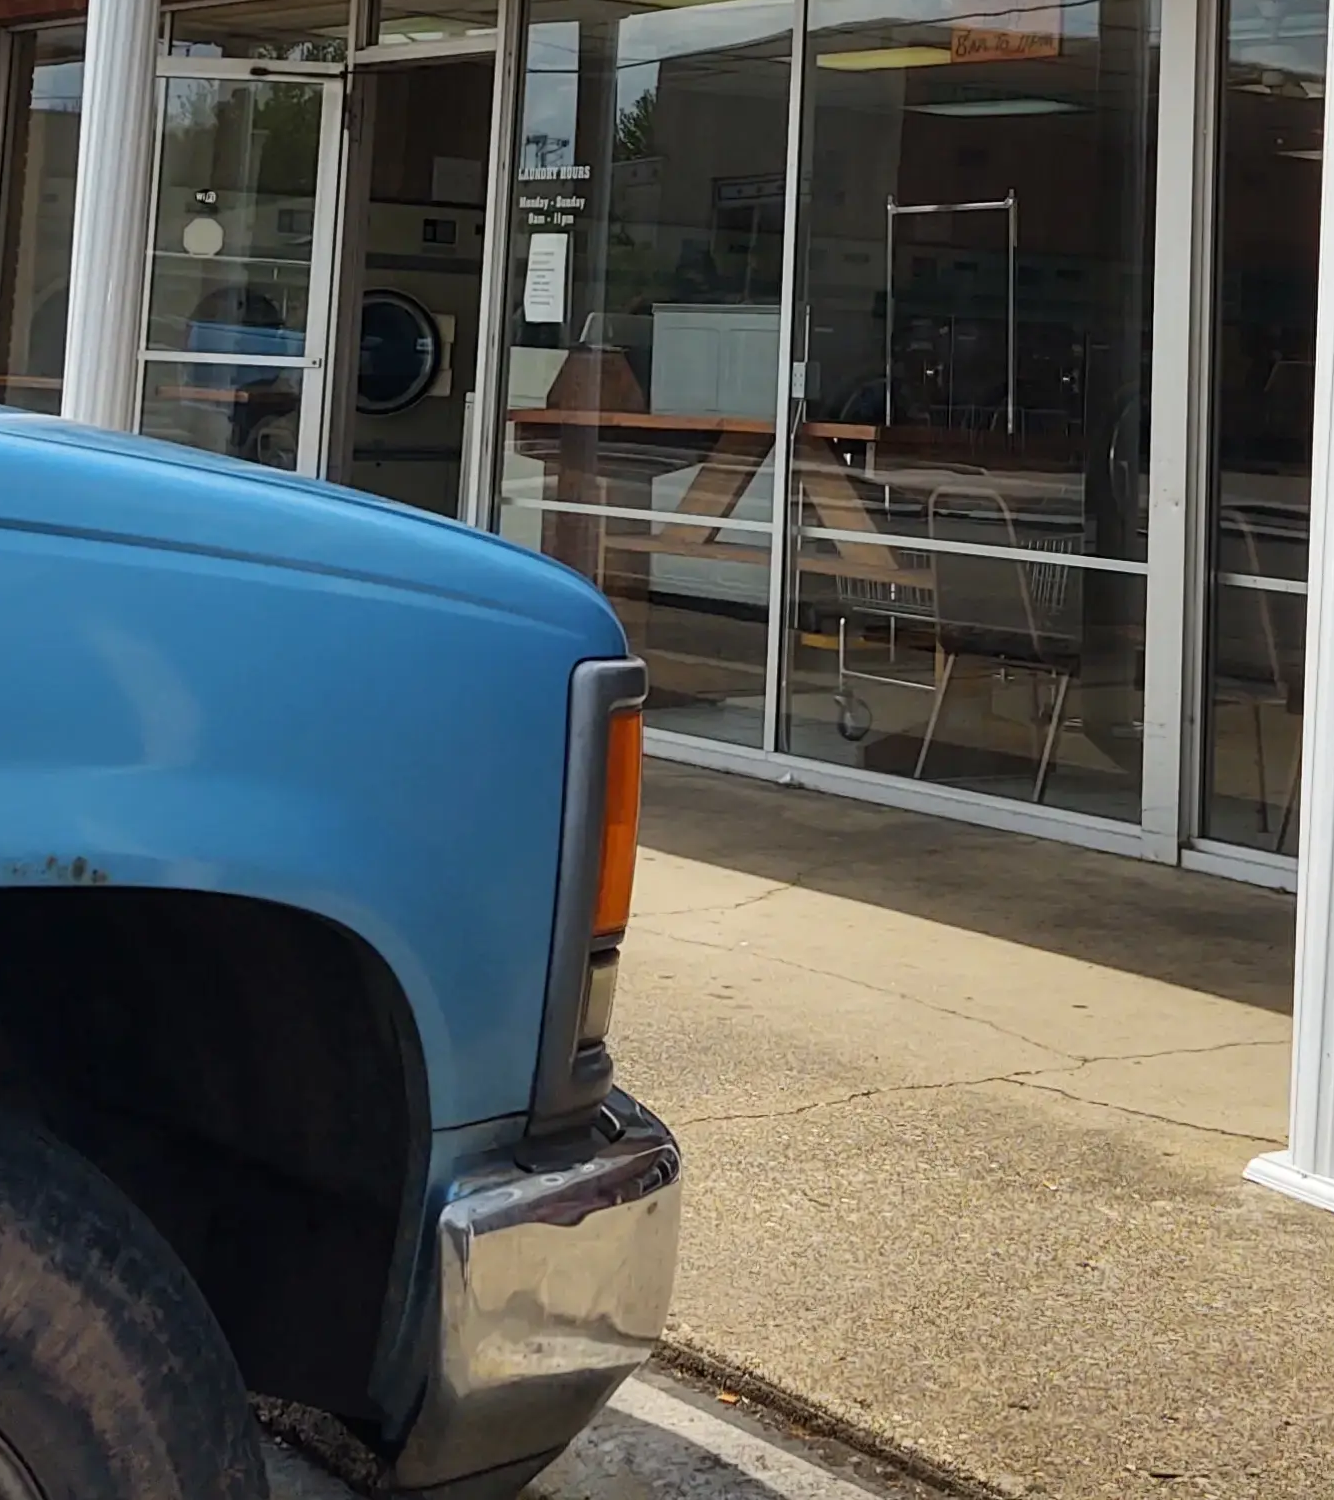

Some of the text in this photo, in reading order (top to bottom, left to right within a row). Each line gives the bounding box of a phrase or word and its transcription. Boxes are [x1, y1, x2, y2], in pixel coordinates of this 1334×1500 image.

[518, 165, 591, 181] LAUNDRY HOURS
[519, 196, 549, 211] Monday
[556, 195, 586, 211] Sunday
